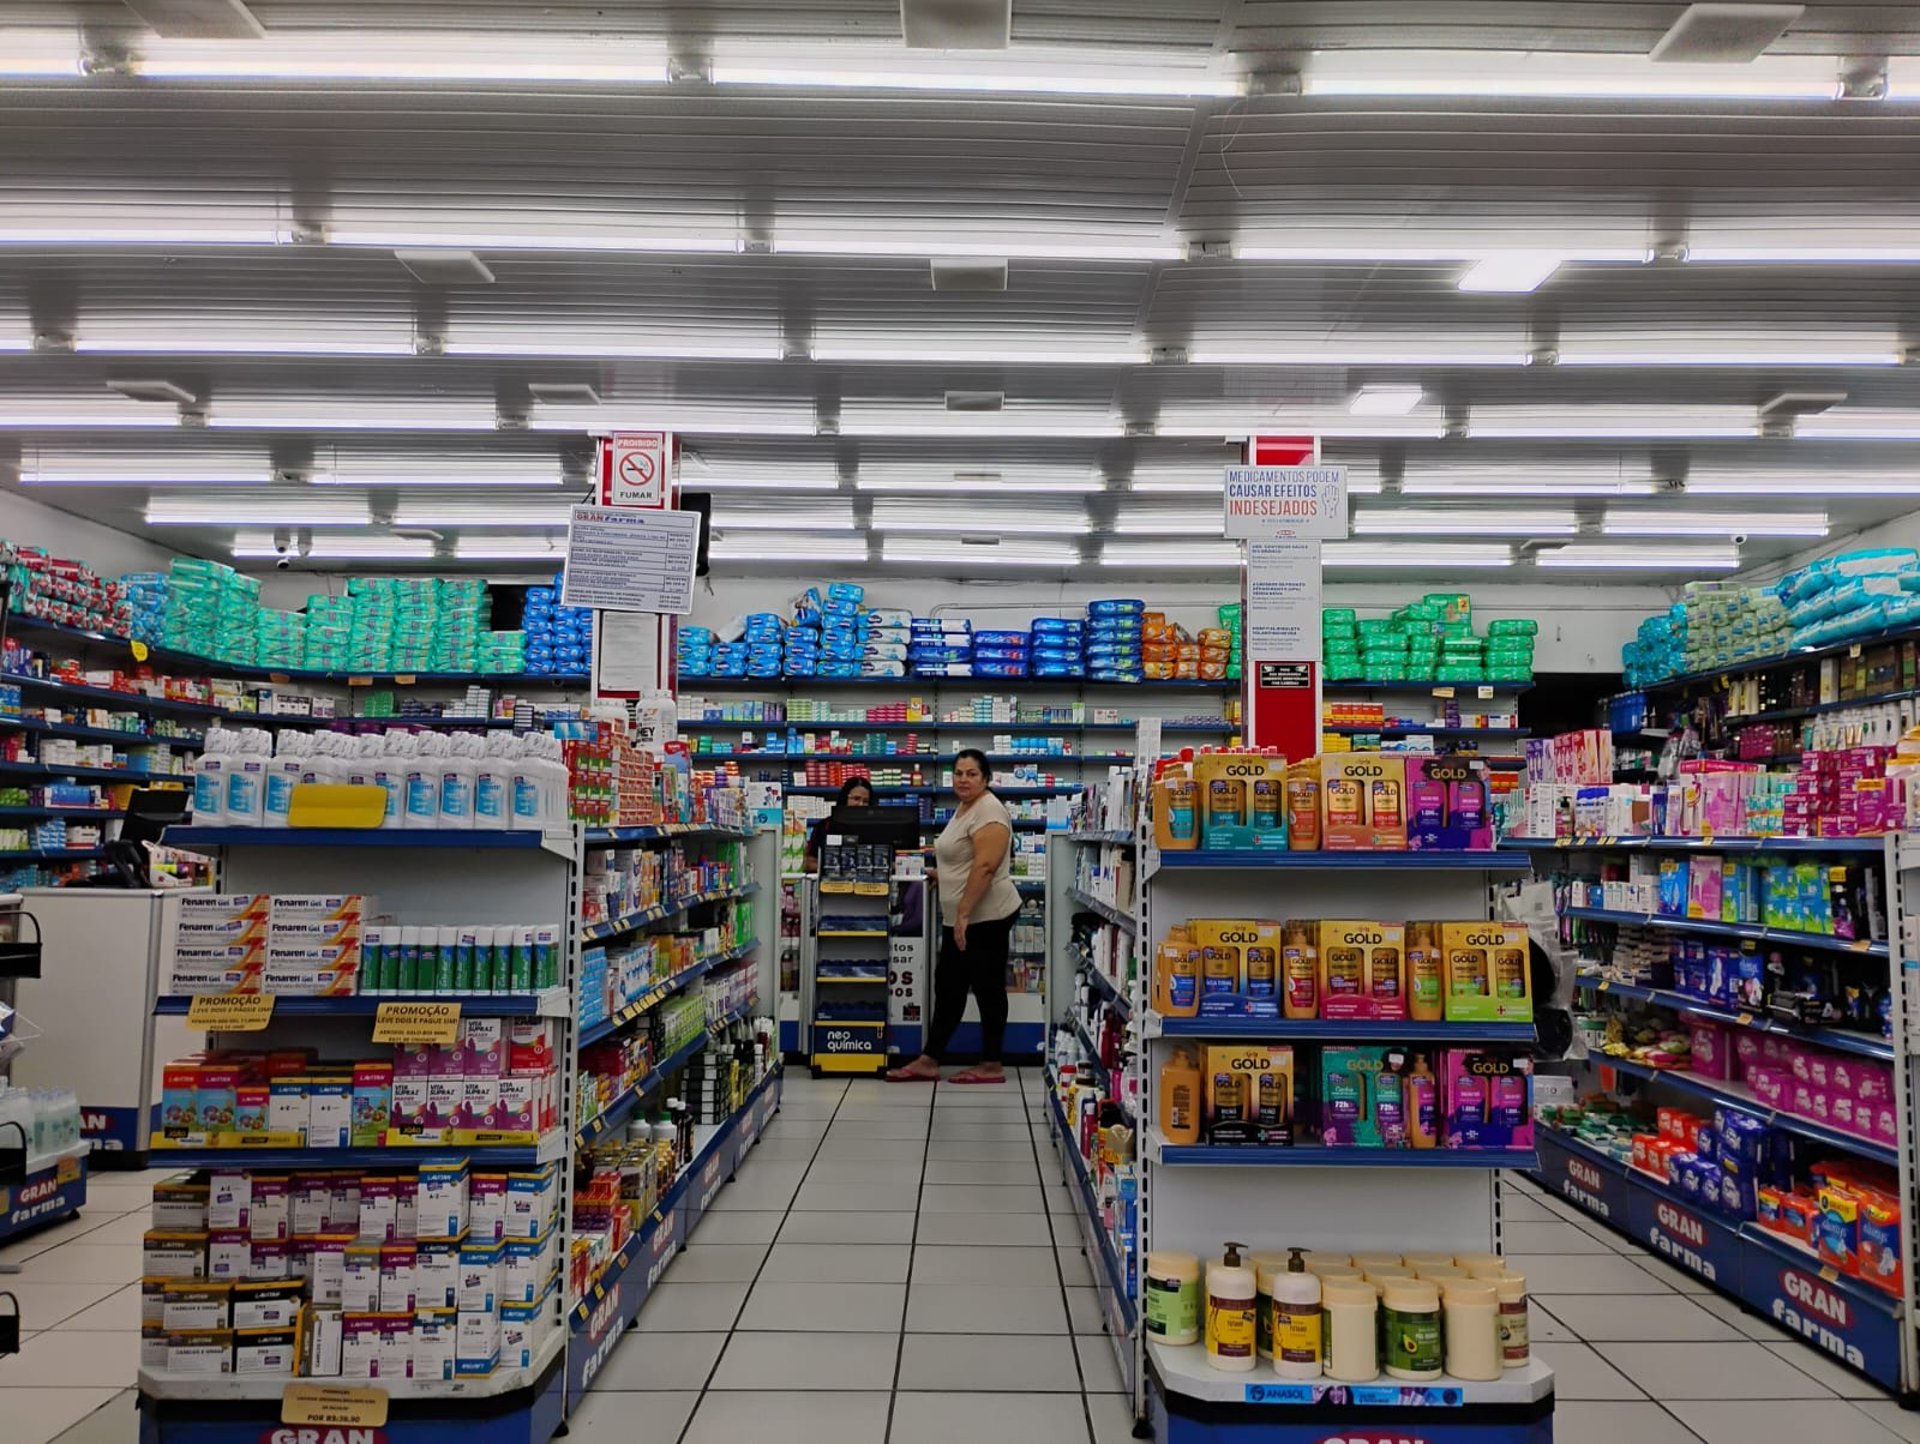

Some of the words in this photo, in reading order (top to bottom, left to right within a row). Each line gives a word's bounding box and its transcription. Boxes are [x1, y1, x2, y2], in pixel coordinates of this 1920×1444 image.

[618, 438, 658, 448] PROIBIDO
[1229, 471, 1306, 482] MEDICAMENTOS
[1306, 471, 1339, 482] PODEM
[620, 491, 653, 499] FUMAR
[1229, 484, 1272, 497] CAUSAR
[1273, 484, 1317, 497] EFEITOS
[1229, 500, 1318, 515] INDESEJADOS
[1226, 765, 1265, 776] GOLD
[1344, 765, 1383, 776] GOLD
[1431, 768, 1467, 779] GOLD
[182, 898, 216, 906] Fenaren
[274, 899, 308, 907] Fenaren
[179, 923, 214, 931] Fenaren
[272, 924, 307, 932] Fenaren
[1220, 932, 1258, 943] GOLD
[1344, 933, 1383, 944] GOLD
[1466, 934, 1505, 945] GOLD
[177, 949, 211, 957] Fenaren
[270, 949, 305, 957] Fenaren
[173, 974, 207, 982] Fenaren
[265, 974, 300, 982] Fenaren
[199, 995, 261, 1006] PROMOÇÃO
[386, 1006, 449, 1017] PROMOÇÃO
[827, 1030, 851, 1039] neo
[1231, 1059, 1271, 1069] GOLD
[1346, 1059, 1384, 1071] GOLD
[1472, 1062, 1509, 1074] GOLD
[1569, 1158, 1600, 1189] GRAN
[20, 1179, 57, 1202] GRAN
[1563, 1179, 1609, 1217] farma
[12, 1196, 66, 1224] farma
[1658, 1203, 1703, 1245] GRAN
[1650, 1227, 1716, 1281] farma
[1784, 1271, 1846, 1325] GRAN
[589, 1283, 620, 1342] GRAN
[1772, 1298, 1865, 1371] farma
[582, 1314, 624, 1390] farma
[1266, 1388, 1304, 1399] ANASOL
[271, 1429, 374, 1444] GRAN
